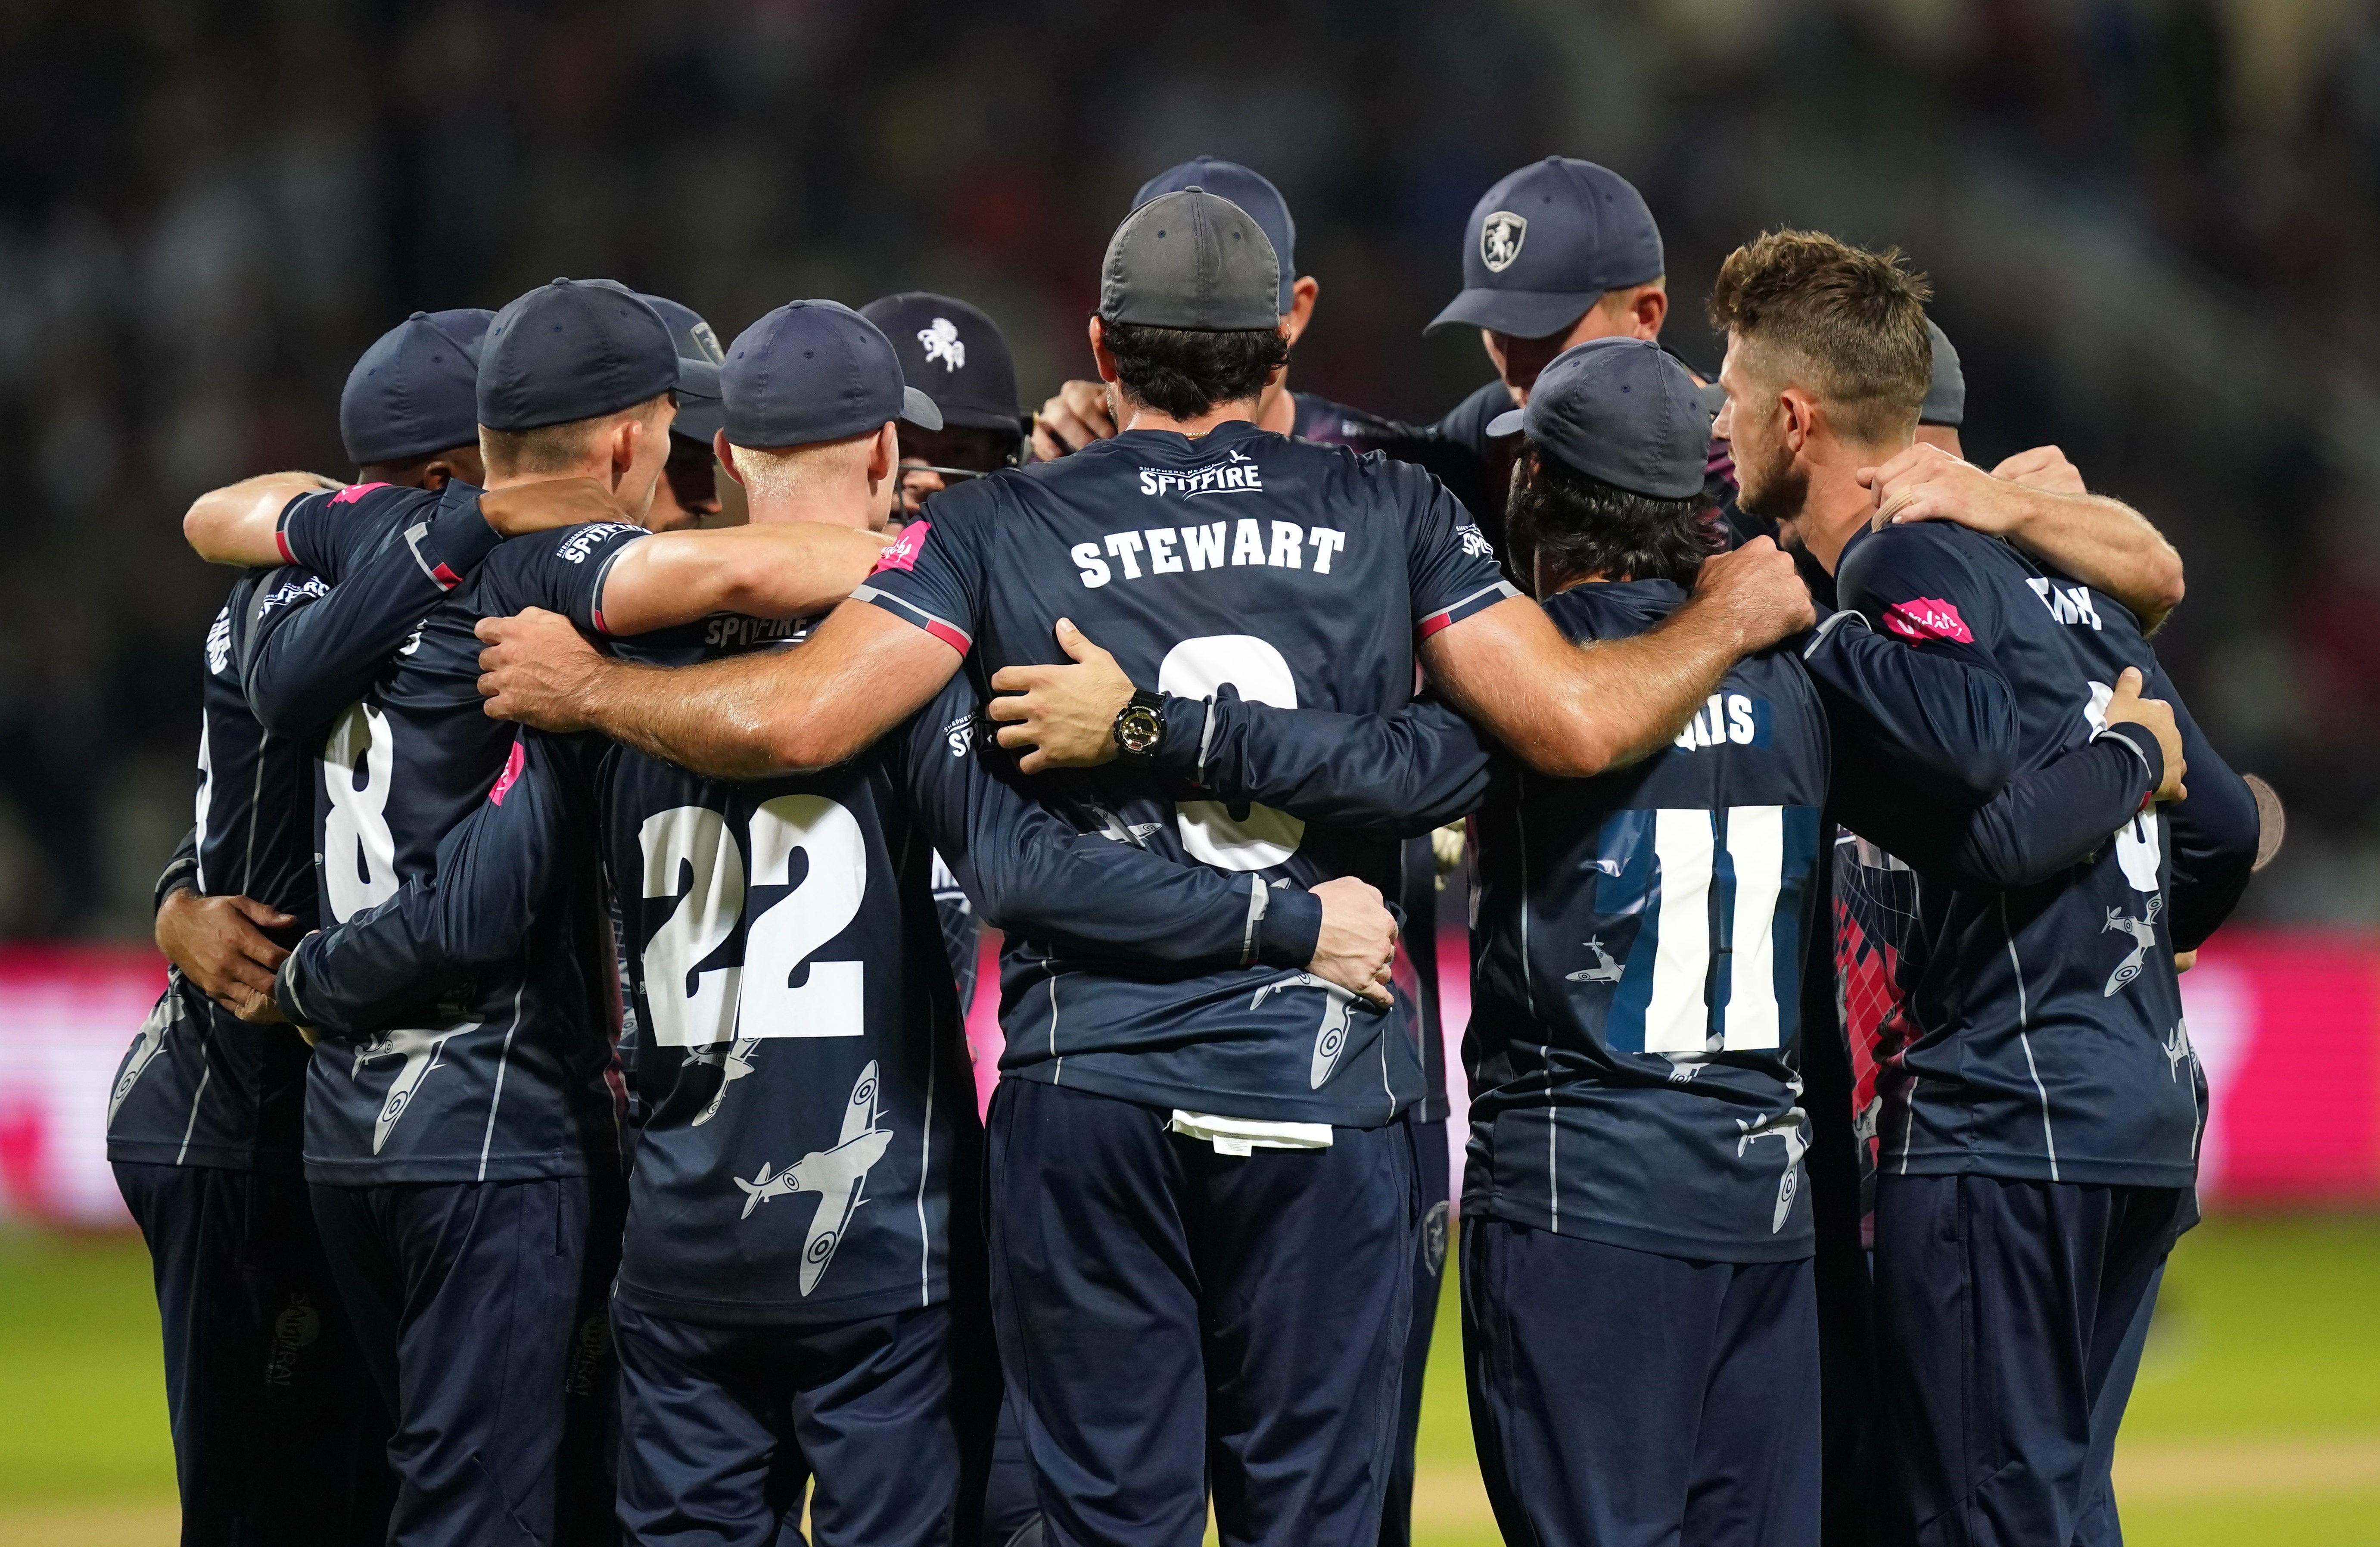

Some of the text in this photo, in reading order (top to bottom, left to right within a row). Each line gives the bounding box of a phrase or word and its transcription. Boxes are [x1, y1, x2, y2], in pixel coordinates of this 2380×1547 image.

[1139, 466, 1185, 475] SHEPHERD
[1140, 465, 1262, 497] SPITFIRE
[556, 530, 584, 557] SHEPHERD
[1070, 518, 1345, 588] STEWART
[705, 617, 807, 648] SPITFIRE
[324, 699, 399, 924] 8
[638, 794, 866, 1047] 22
[1645, 805, 1783, 1053] 11
